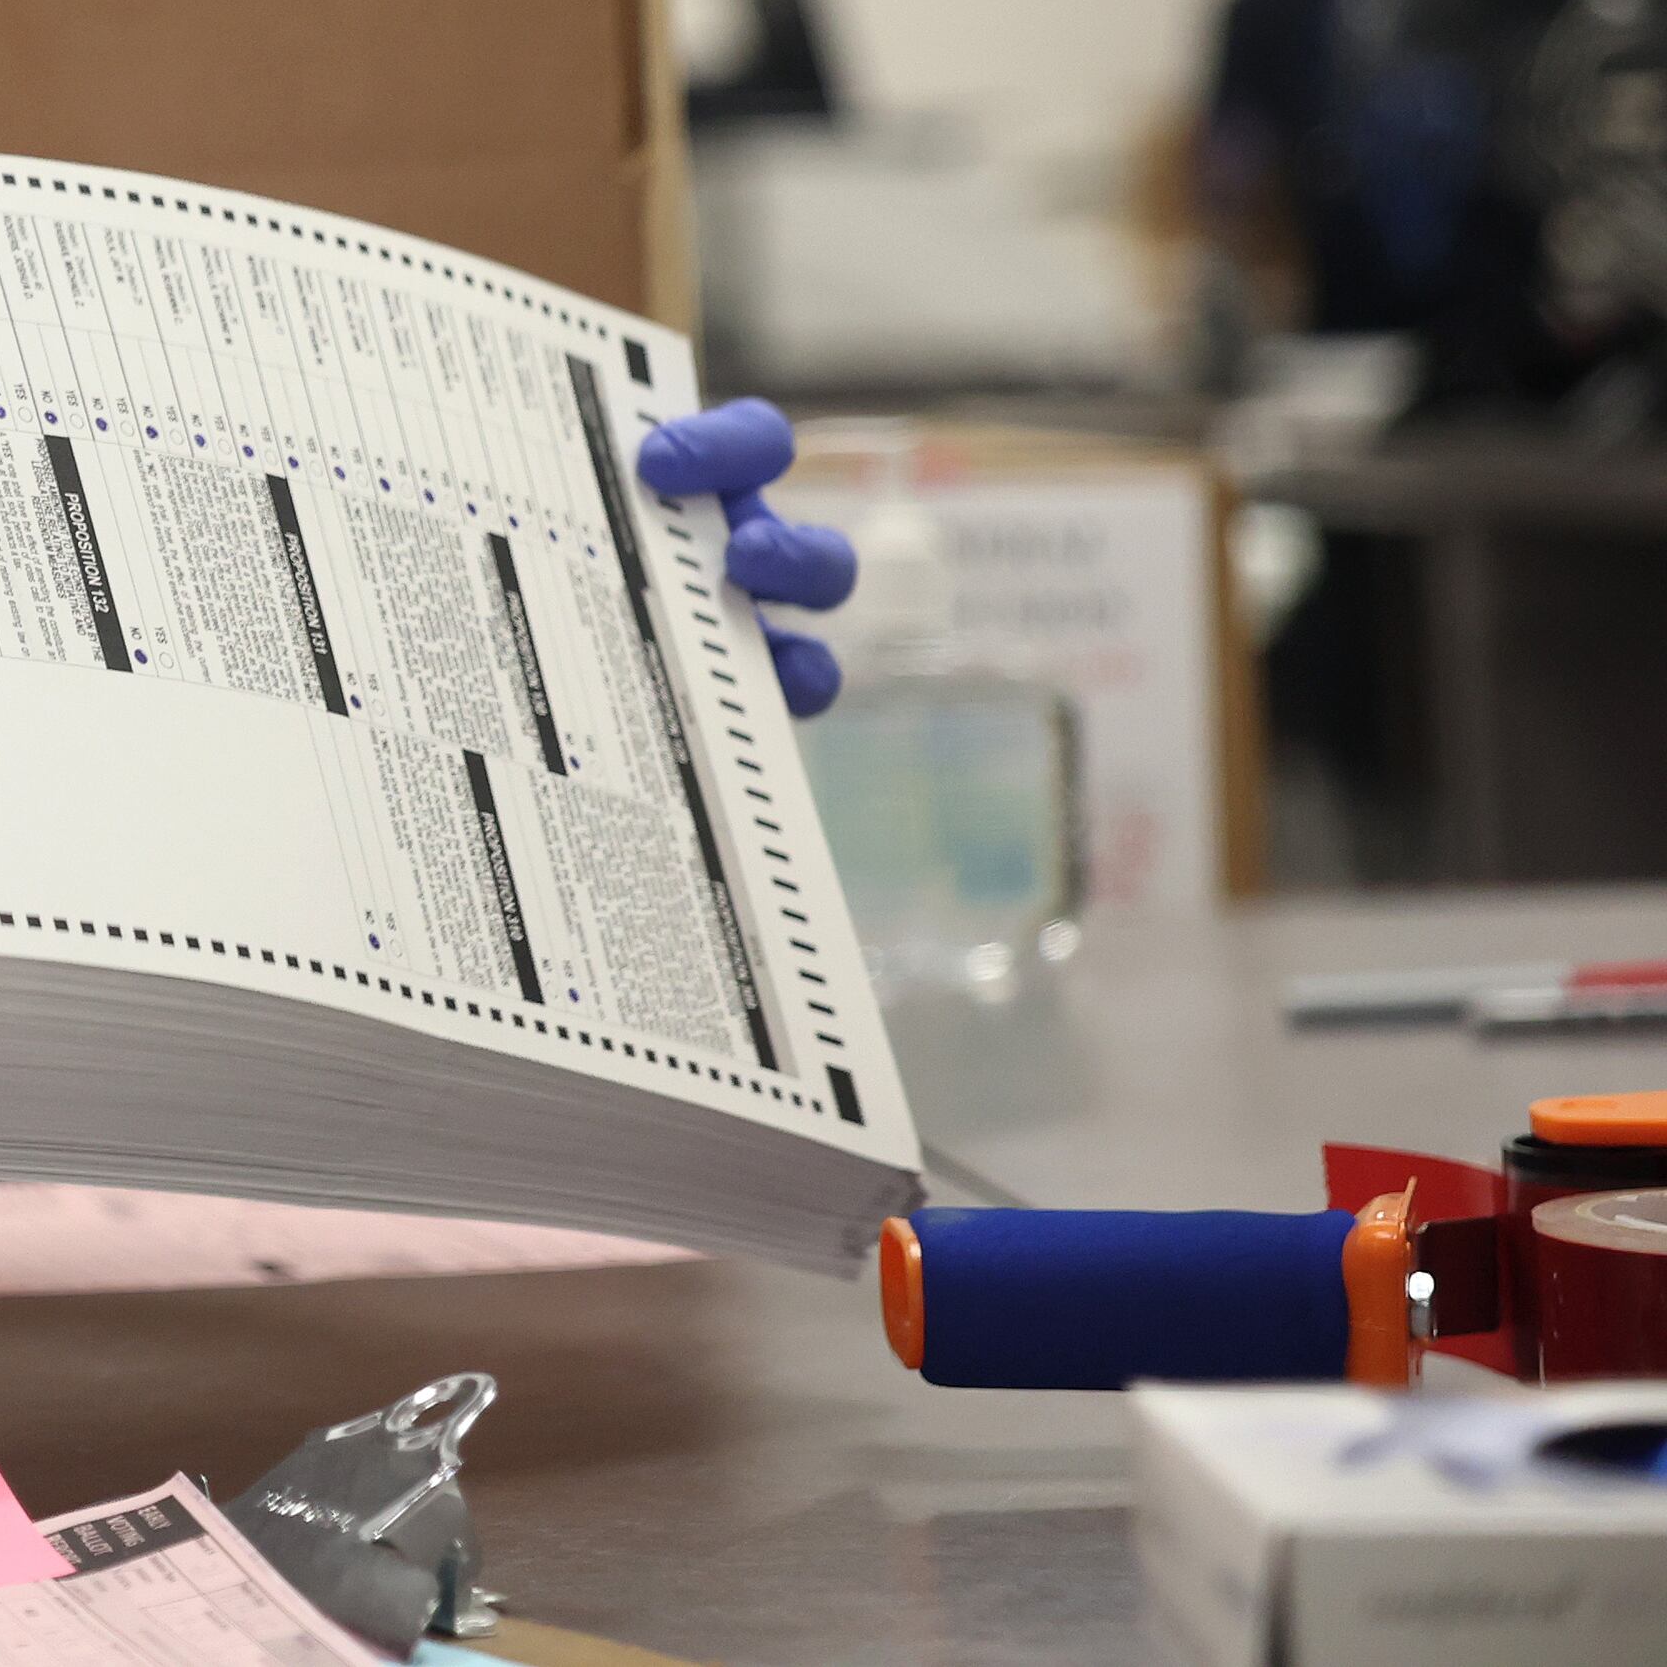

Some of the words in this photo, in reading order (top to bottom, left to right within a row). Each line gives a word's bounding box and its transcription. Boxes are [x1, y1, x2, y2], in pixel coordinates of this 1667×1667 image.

[36, 437, 57, 483] PROPOSED
[31, 460, 54, 516] LEGISLATURE
[48, 484, 70, 536] AMENDMENT
[31, 495, 53, 552] REFERENDUM
[47, 553, 67, 599] MEASURES
[47, 518, 66, 559] RELATING
[62, 538, 74, 550] TO
[66, 492, 101, 586] PROPOSITION
[91, 589, 109, 613] 132
[57, 561, 70, 573] TO
[66, 551, 79, 568] THE
[62, 574, 81, 616] INITIATIVE
[70, 569, 94, 630] CONSTITUTION
[286, 533, 319, 628] PROPOSITION
[310, 632, 327, 654] 131
[74, 617, 86, 636] AND
[87, 631, 98, 642] BY
[92, 645, 104, 661] THE
[482, 812, 515, 912] PROPOSITION
[505, 914, 523, 941] 310
[106, 1514, 146, 1548] VOTING
[137, 1505, 172, 1530] EARLY
[73, 1523, 114, 1556] BALLOT
